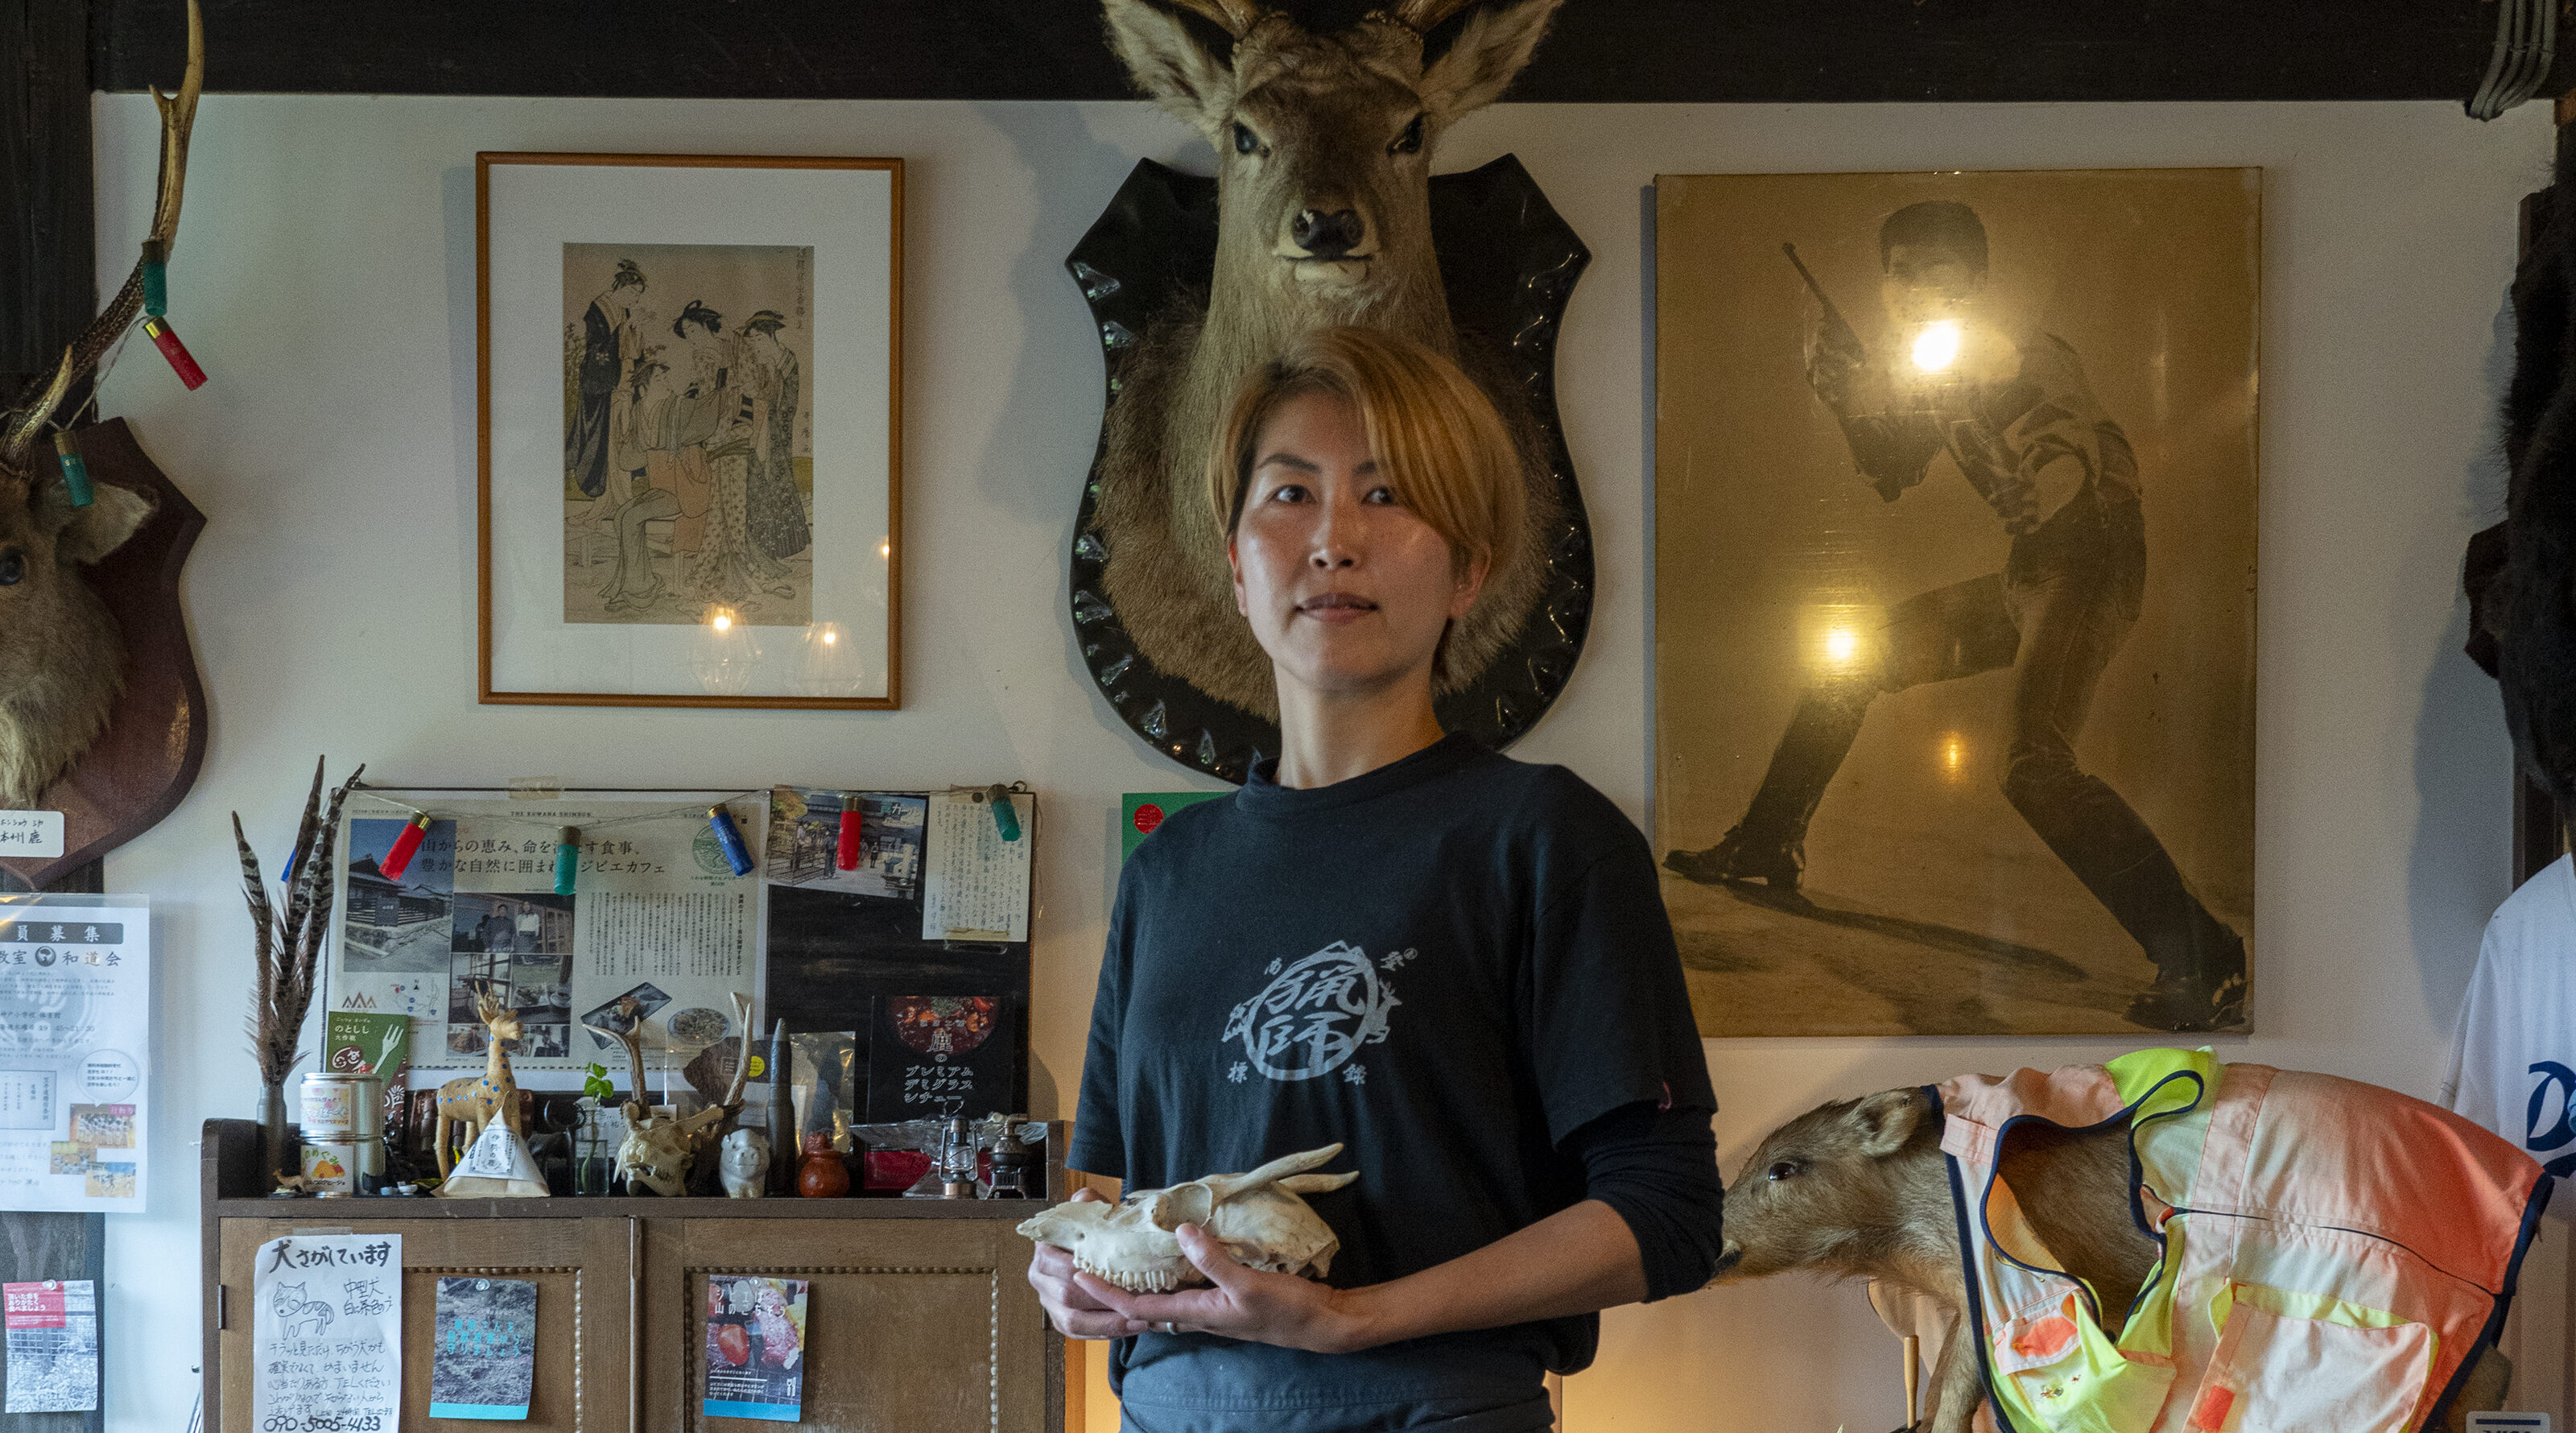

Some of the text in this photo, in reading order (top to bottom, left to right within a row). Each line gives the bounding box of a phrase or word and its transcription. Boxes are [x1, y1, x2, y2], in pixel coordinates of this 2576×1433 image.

[0, 830, 43, 844] 本州鹿
[421, 858, 665, 874] 豊かな自然に囲まれジビエカフェ
[61, 950, 122, 967] 和道会
[334, 1024, 370, 1034] のとしし
[926, 1028, 954, 1053] 鹿
[935, 1053, 948, 1063] の
[904, 1065, 975, 1078] プレミアム
[904, 1078, 974, 1091] デミグラス
[903, 1091, 963, 1104] シチュー
[268, 1239, 391, 1274] 犬さがしています
[343, 1277, 384, 1299] 中型犬
[714, 1303, 786, 1318] 山のごちそう
